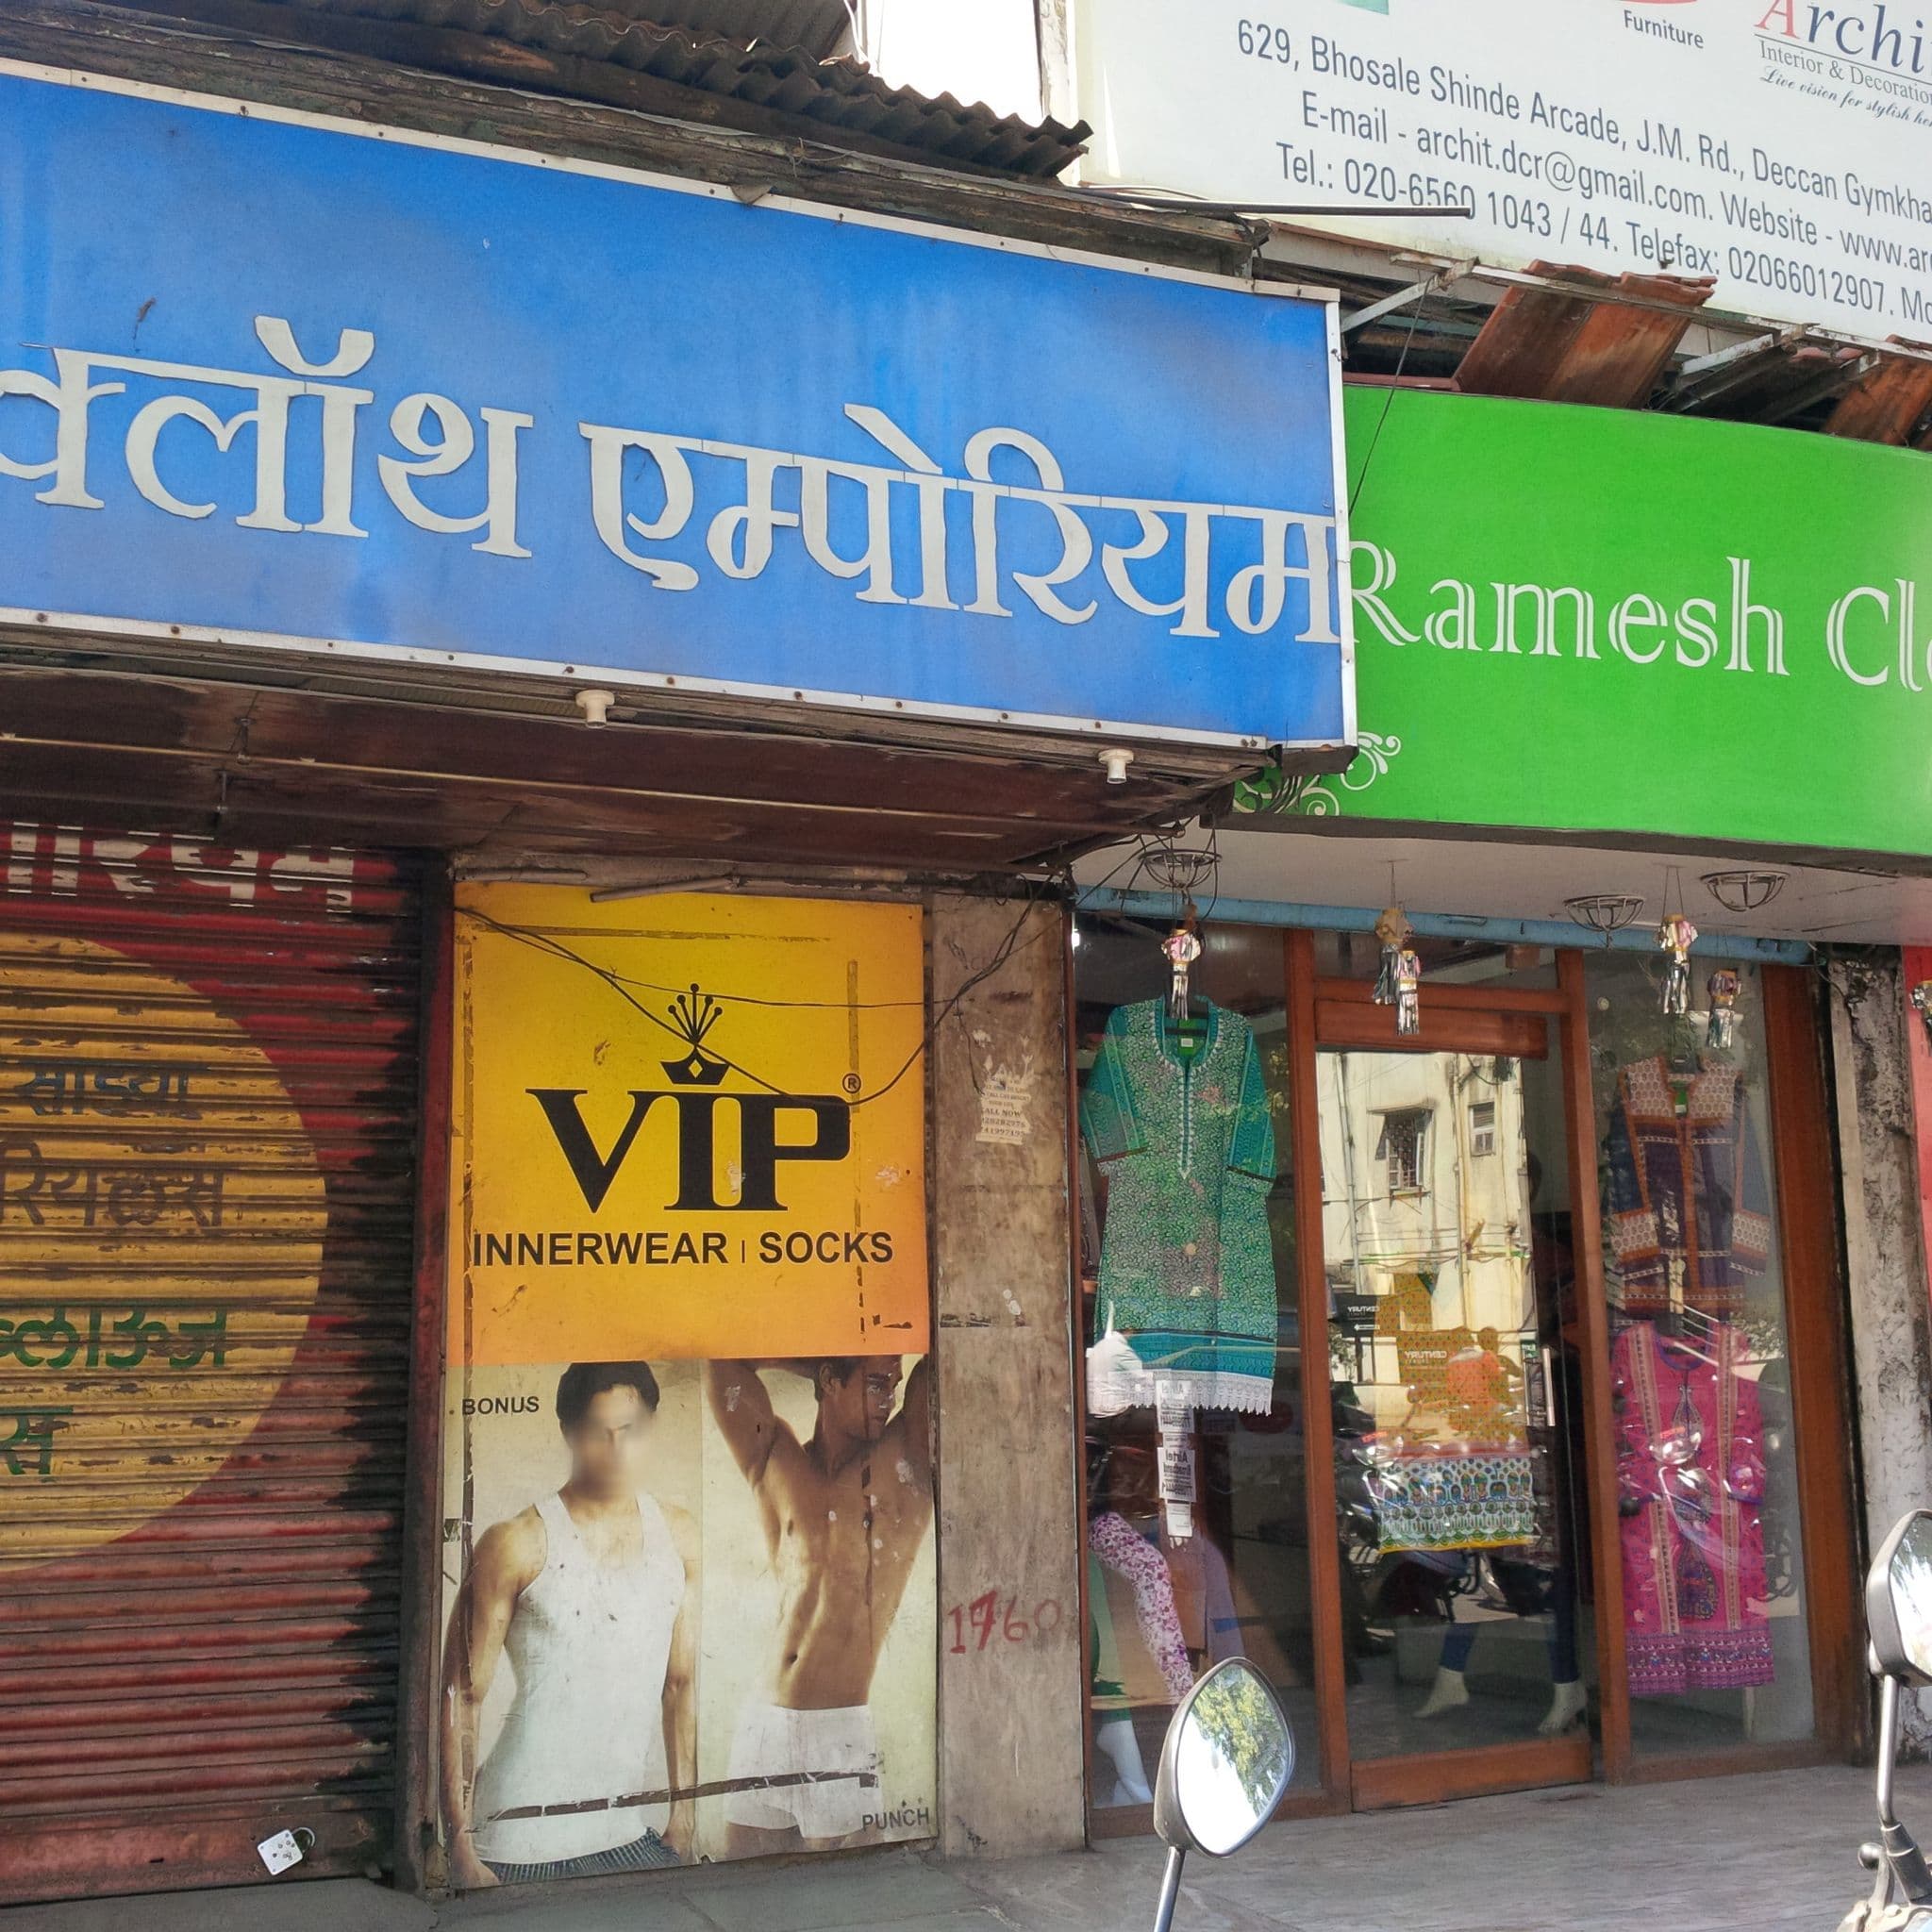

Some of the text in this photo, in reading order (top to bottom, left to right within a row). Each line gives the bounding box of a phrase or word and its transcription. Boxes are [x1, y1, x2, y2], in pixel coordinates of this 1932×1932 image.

[1624, 9, 1704, 49] Furniture
[1753, 0, 1932, 74] Archi
[1759, 40, 1824, 75] Interior
[1829, 59, 1844, 81] &
[1238, 19, 1299, 72] 629,
[1312, 35, 1421, 95] Bhosale
[1430, 65, 1520, 121] Shinde
[1530, 92, 1626, 151] Arcade,
[1637, 119, 1690, 163] J.M.
[1699, 134, 1744, 181] Rd.,
[1753, 147, 1838, 200] Deccan
[1799, 82, 1838, 102] vision
[1840, 91, 1863, 108] for
[1866, 100, 1911, 121] stylish
[1913, 109, 1932, 127] ho
[1303, 91, 1388, 144] E-mail
[1417, 127, 1713, 221] archit.dcr@gmail.com.
[1721, 191, 1817, 245] Website
[1840, 229, 1932, 274] www.ar
[1488, 191, 1552, 237] 1043
[1579, 213, 1618, 252] 44.
[578, 404, 1342, 645] एम्पोरियम
[1349, 539, 1932, 692] Ramesh Cl
[525, 1088, 851, 1214] VIP
[473, 1230, 893, 1267] INNERWEAR SOCKS
[461, 1395, 541, 1417] BONUS
[861, 1807, 930, 1832] PUNCH
